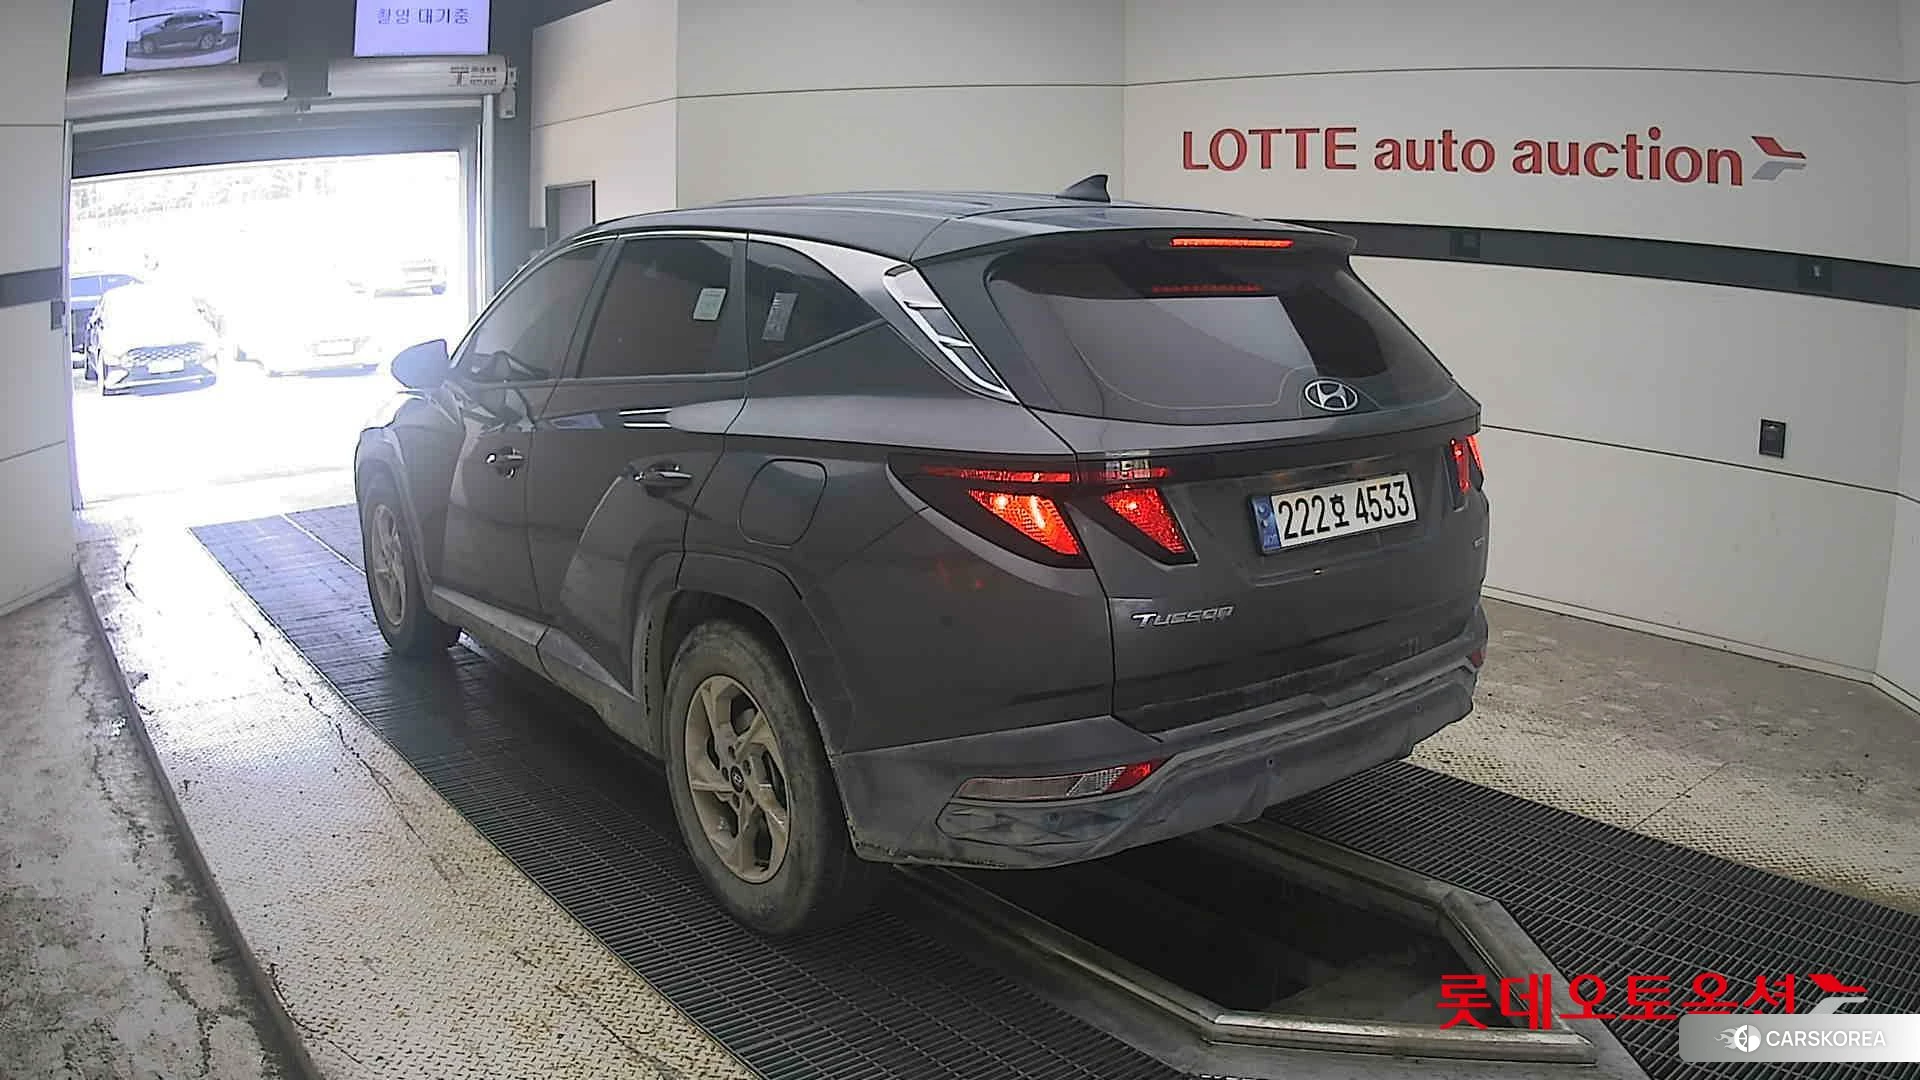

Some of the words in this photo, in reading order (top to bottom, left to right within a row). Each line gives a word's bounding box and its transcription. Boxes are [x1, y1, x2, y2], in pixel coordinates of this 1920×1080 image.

[418, 8, 469, 24] 대기중
[1183, 127, 1357, 171] LOTTE
[1374, 128, 1496, 173] auto
[1512, 126, 1744, 187] auction
[1278, 494, 1350, 540] 222호
[1355, 480, 1410, 524] 4533
